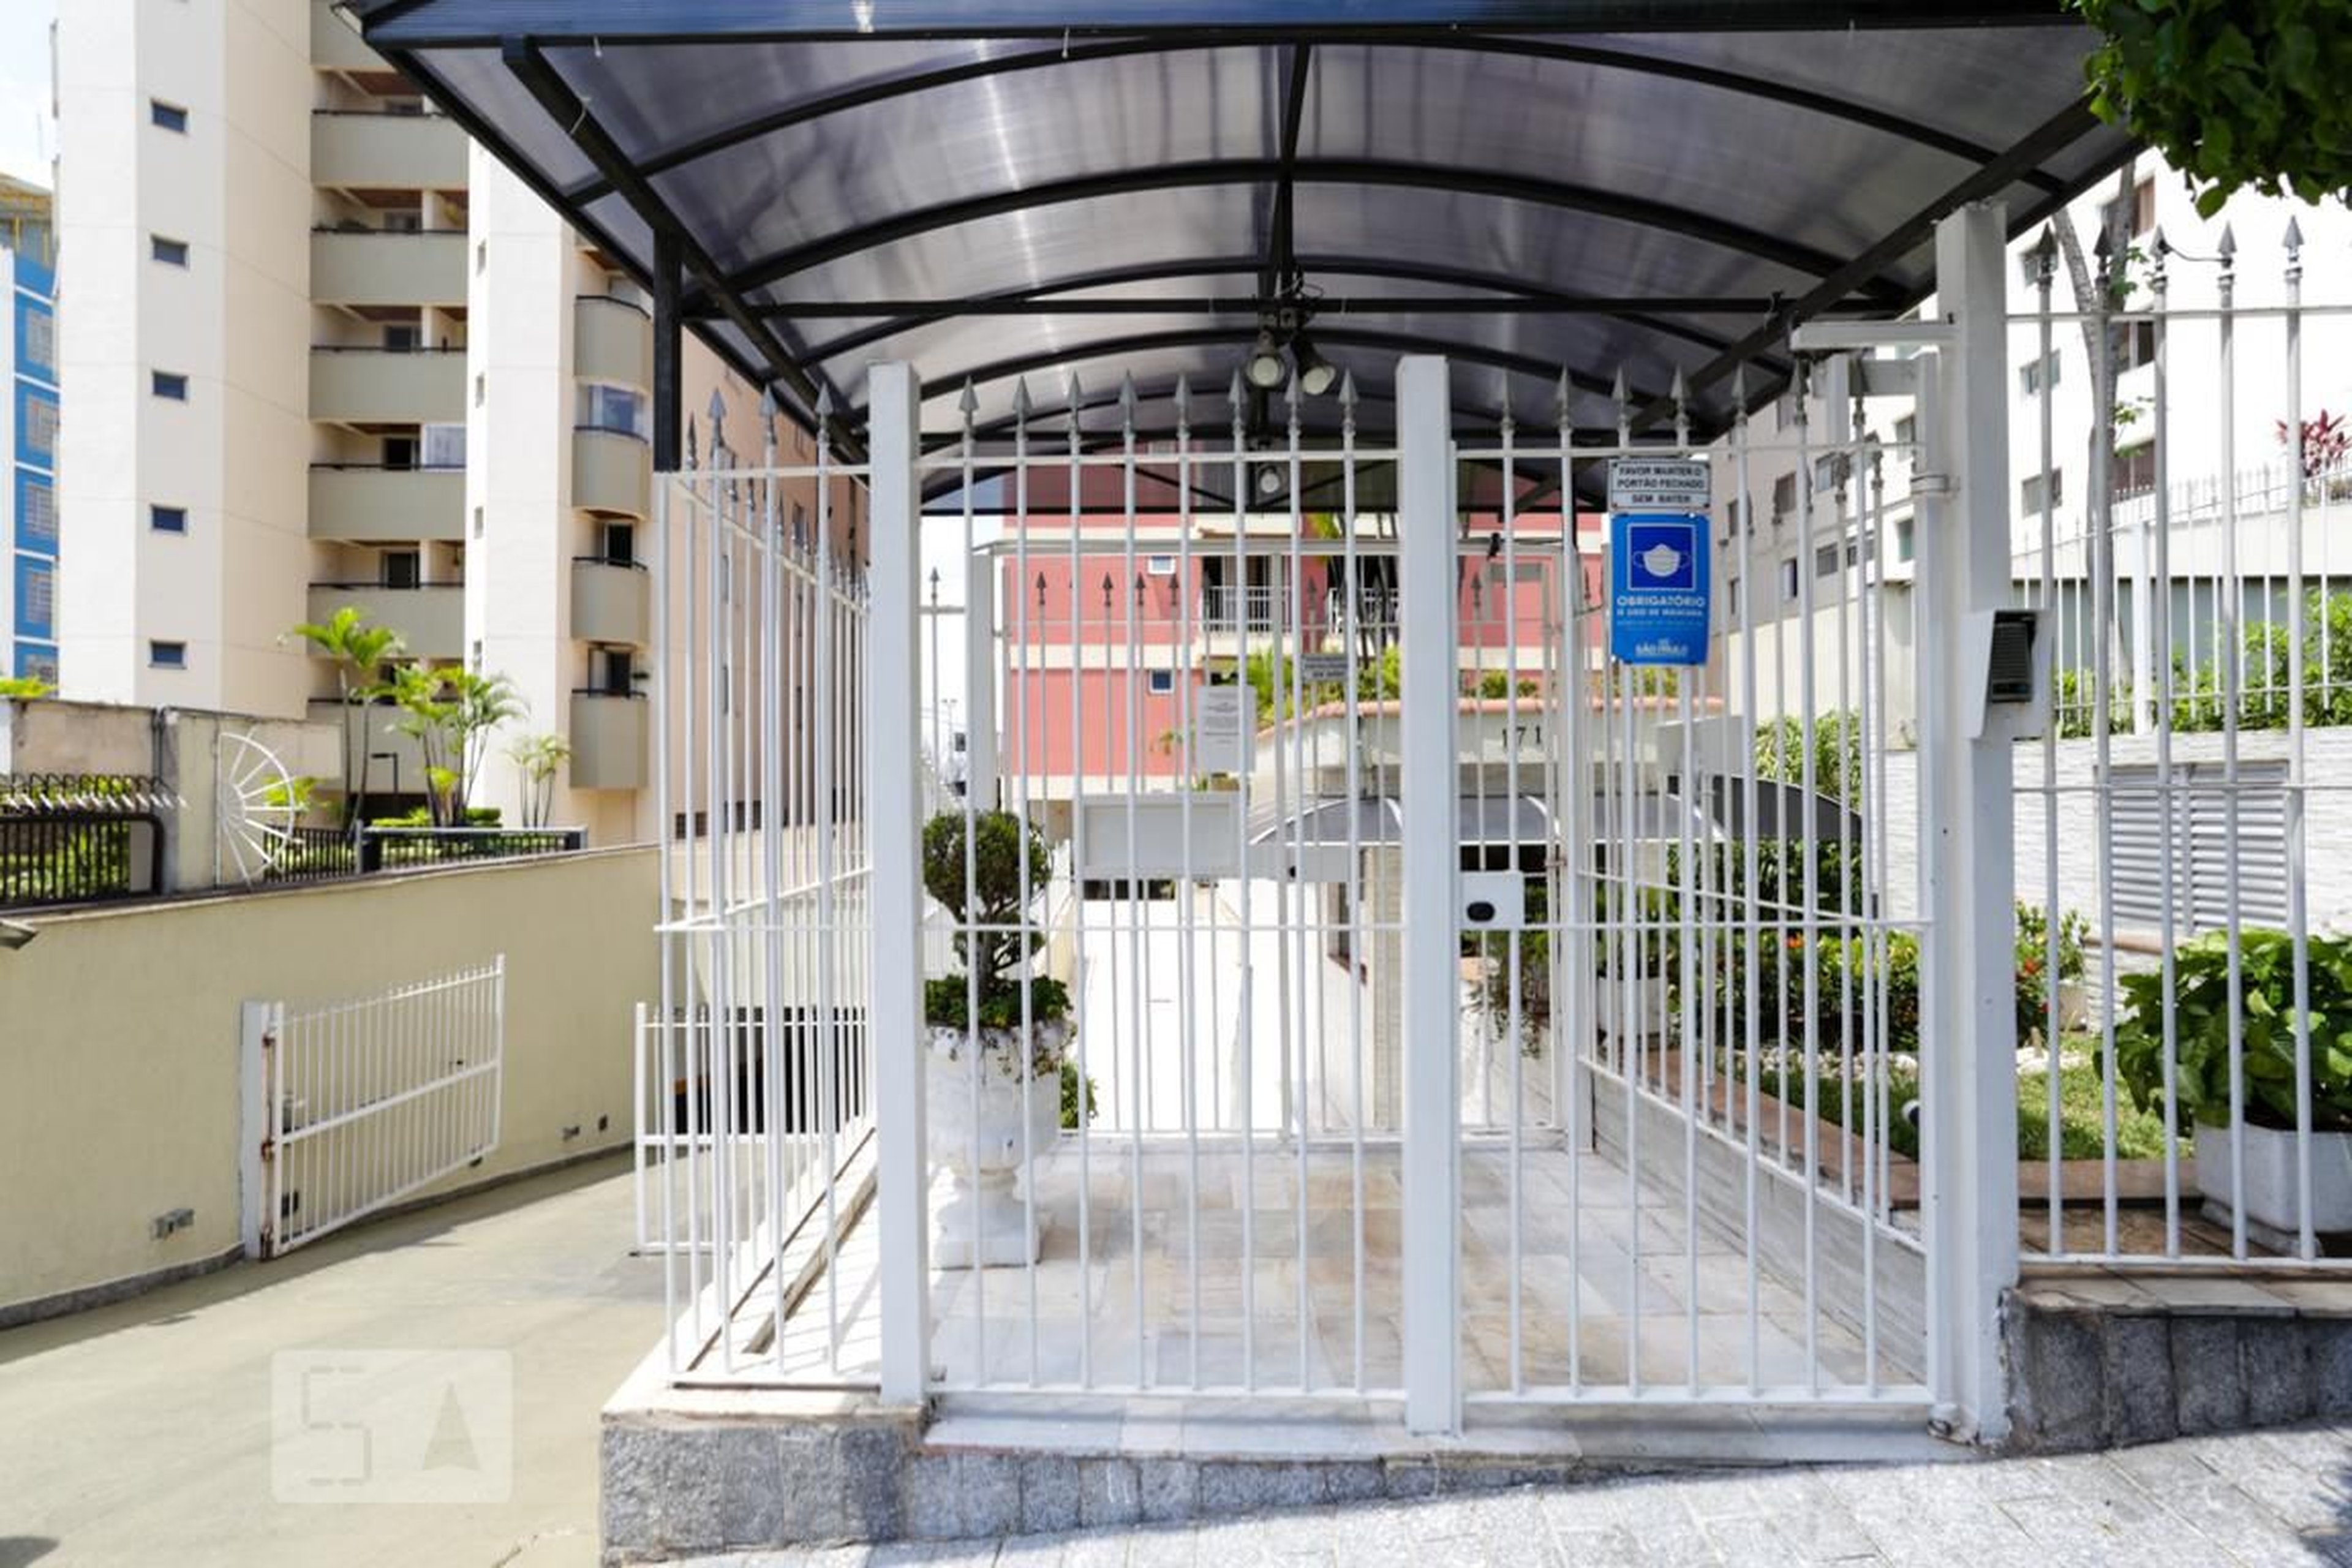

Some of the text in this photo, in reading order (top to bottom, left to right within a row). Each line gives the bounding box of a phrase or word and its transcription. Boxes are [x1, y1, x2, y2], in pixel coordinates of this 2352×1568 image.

[1619, 467, 1651, 475] FAVOR
[1654, 467, 1692, 476] MANTER
[1617, 478, 1705, 488] PORTÃO FECHADO
[1616, 595, 1706, 607] OBRIGATÓRIO
